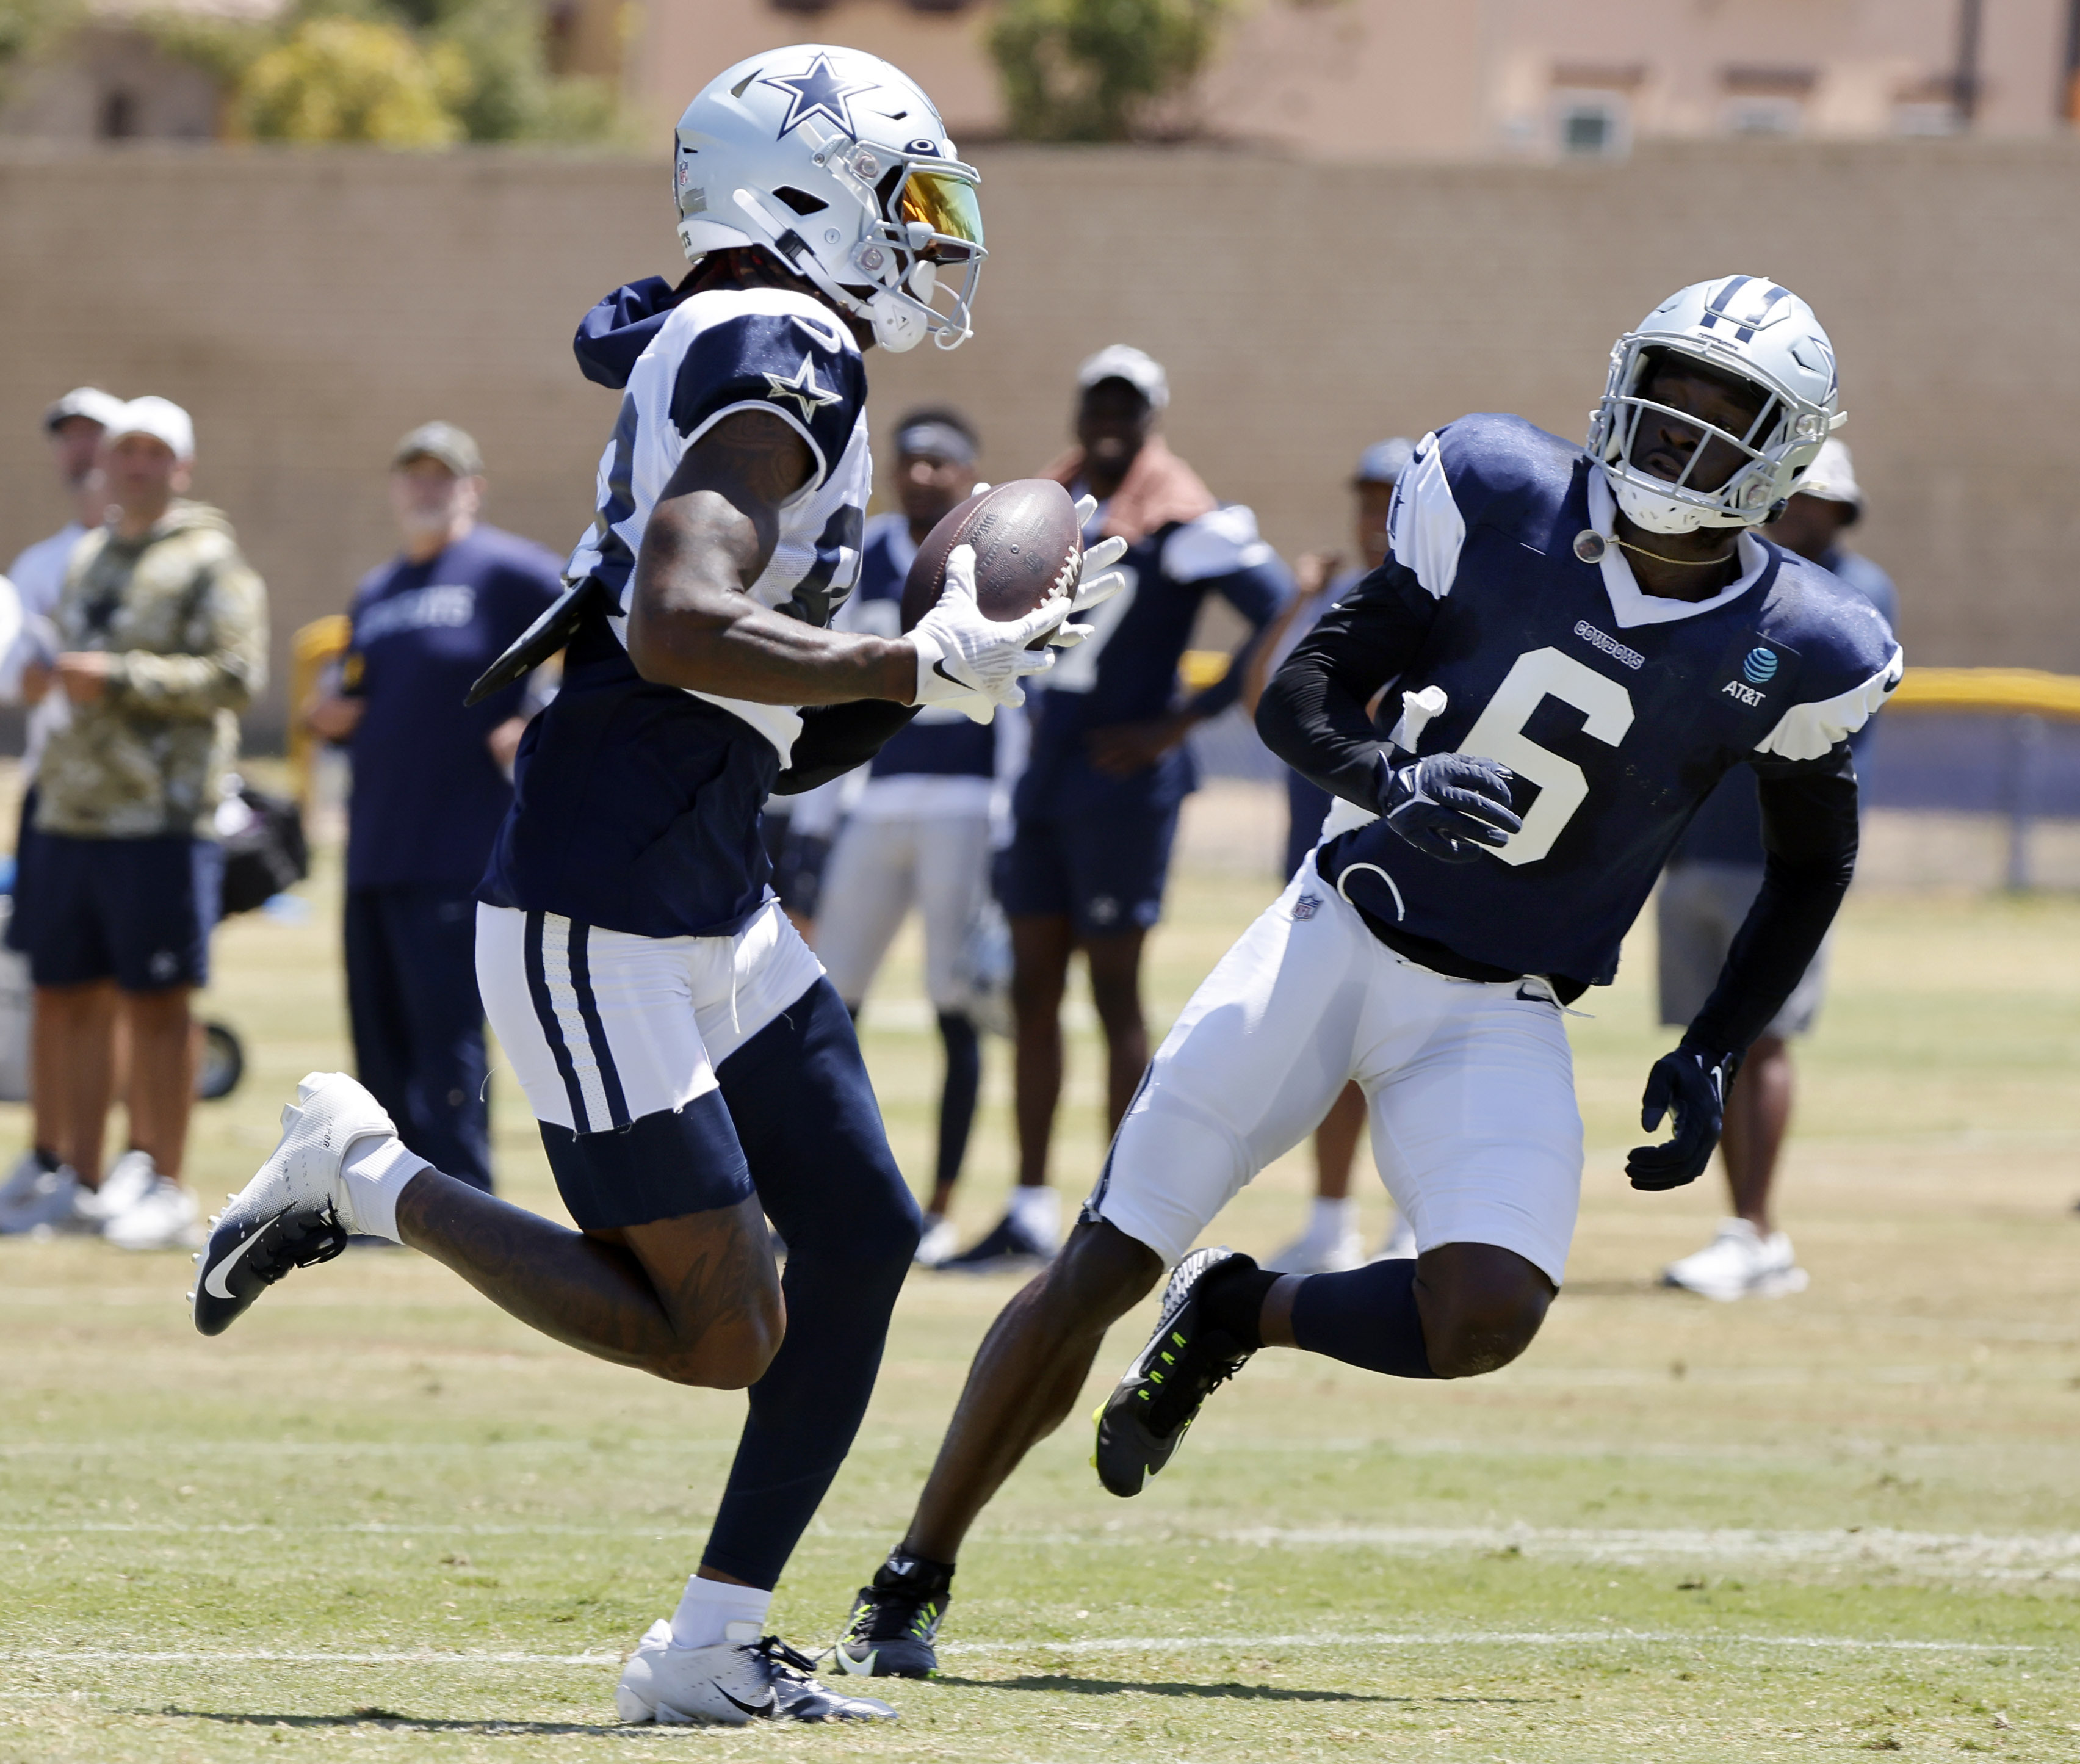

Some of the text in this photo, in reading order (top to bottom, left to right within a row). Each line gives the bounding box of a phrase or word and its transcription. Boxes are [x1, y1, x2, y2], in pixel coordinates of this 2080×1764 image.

[1573, 620, 1645, 670] COWBOYS
[1721, 679, 1767, 707] AT&T
[1450, 645, 1636, 866] 6
